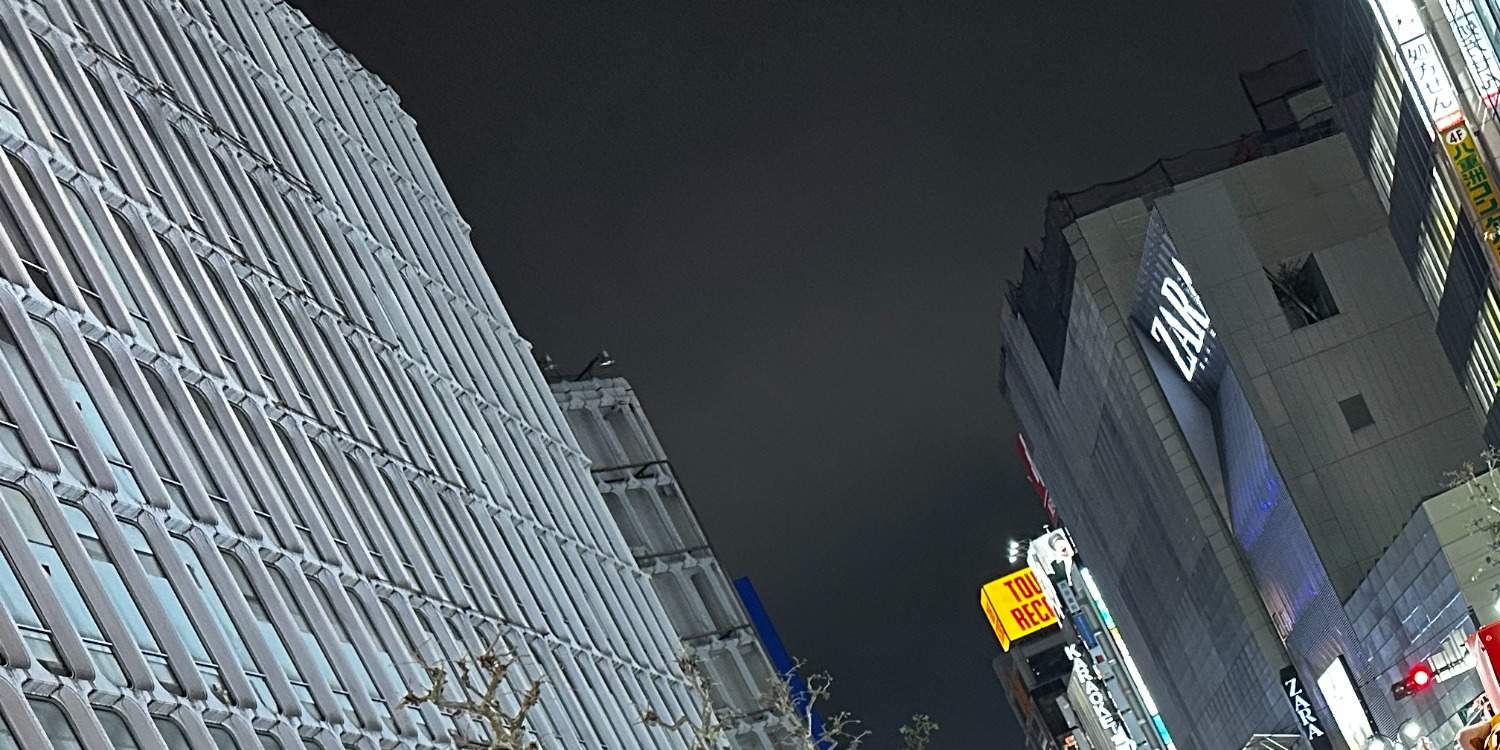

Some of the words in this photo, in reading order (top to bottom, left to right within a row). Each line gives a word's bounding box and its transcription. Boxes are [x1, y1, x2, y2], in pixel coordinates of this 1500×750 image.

[1407, 43, 1453, 113] 処方せん
[1450, 129, 1463, 144] 4F
[1064, 643, 1116, 730] KARAOKE
[1284, 677, 1325, 741] ZARA
